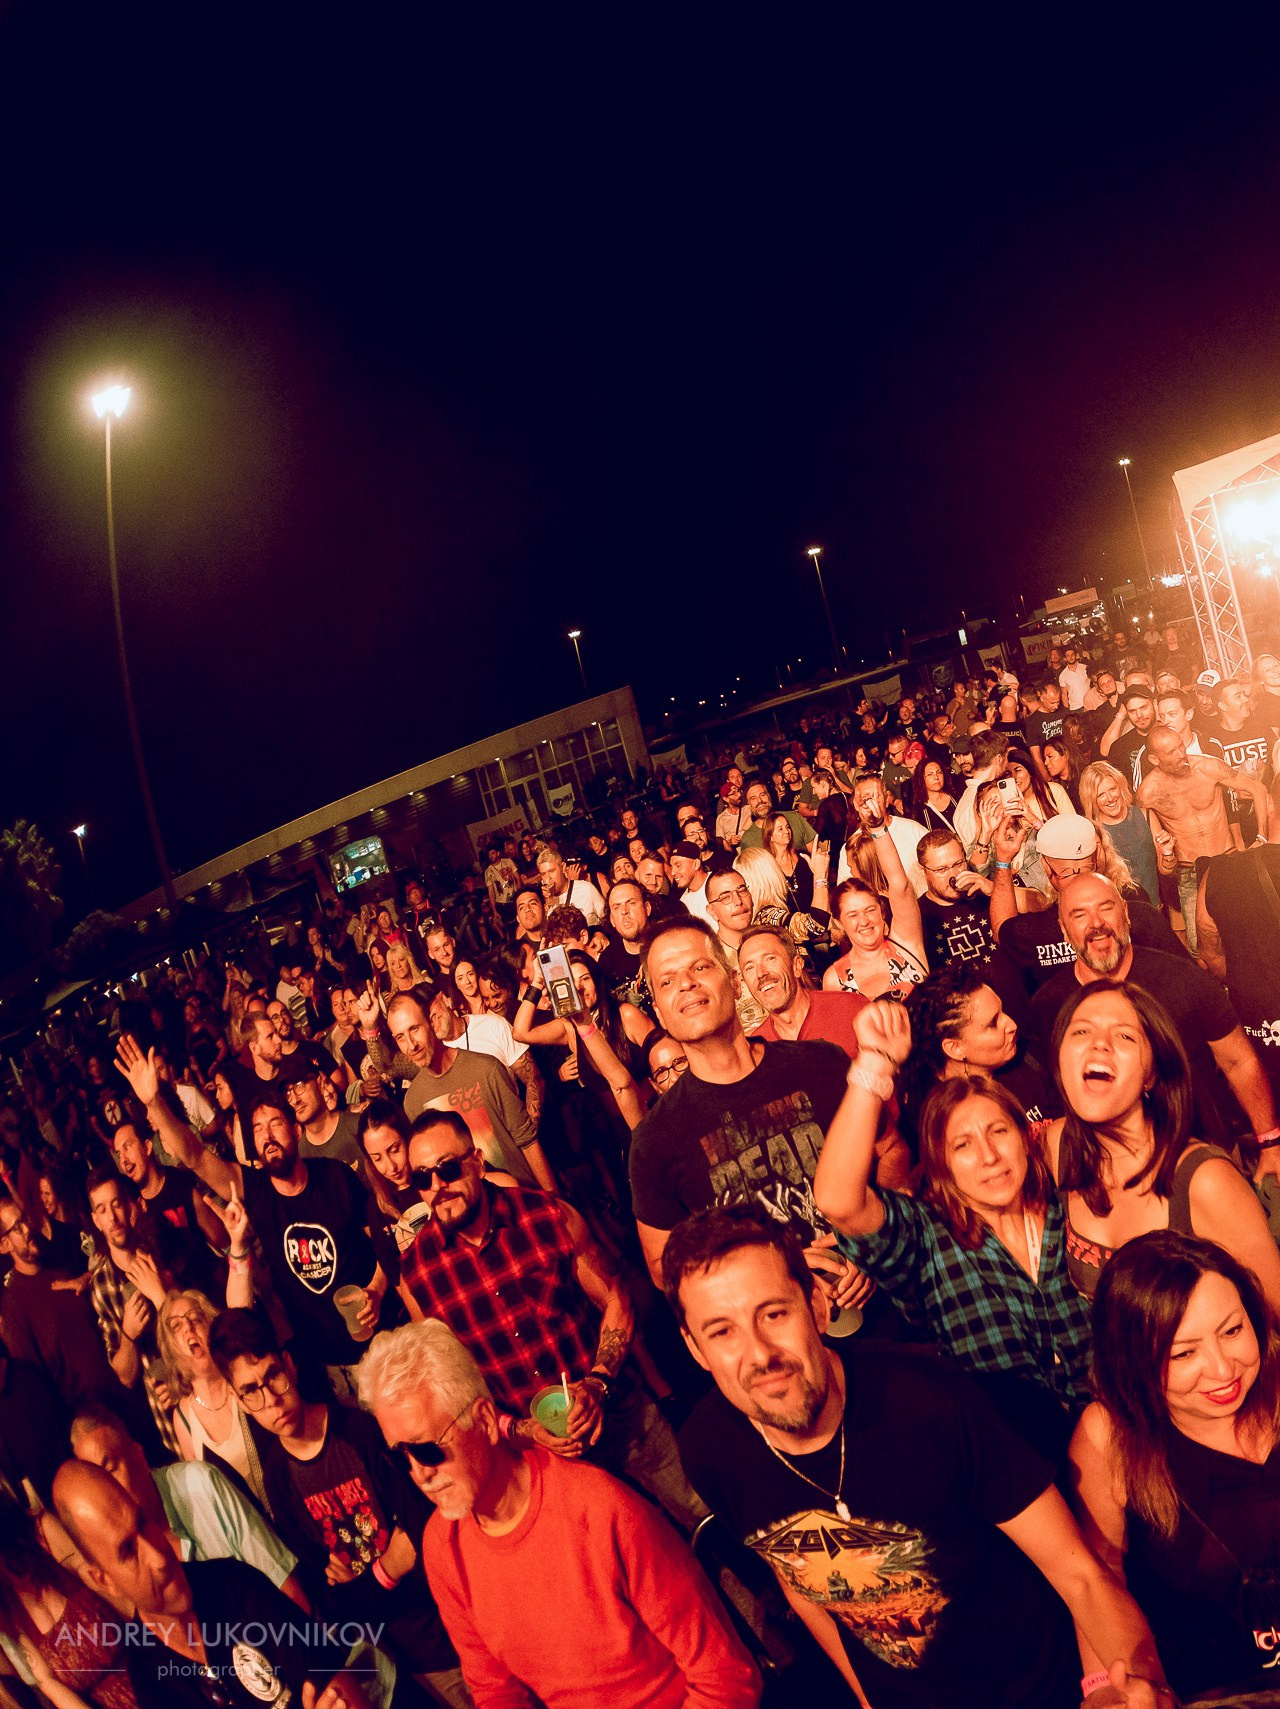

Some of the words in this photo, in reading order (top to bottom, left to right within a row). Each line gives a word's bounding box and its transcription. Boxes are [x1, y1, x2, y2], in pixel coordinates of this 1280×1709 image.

[1036, 941, 1076, 960] PINK
[1052, 957, 1071, 966] DARK
[1243, 1025, 1268, 1038] Fuck
[300, 1266, 333, 1279] CANCER
